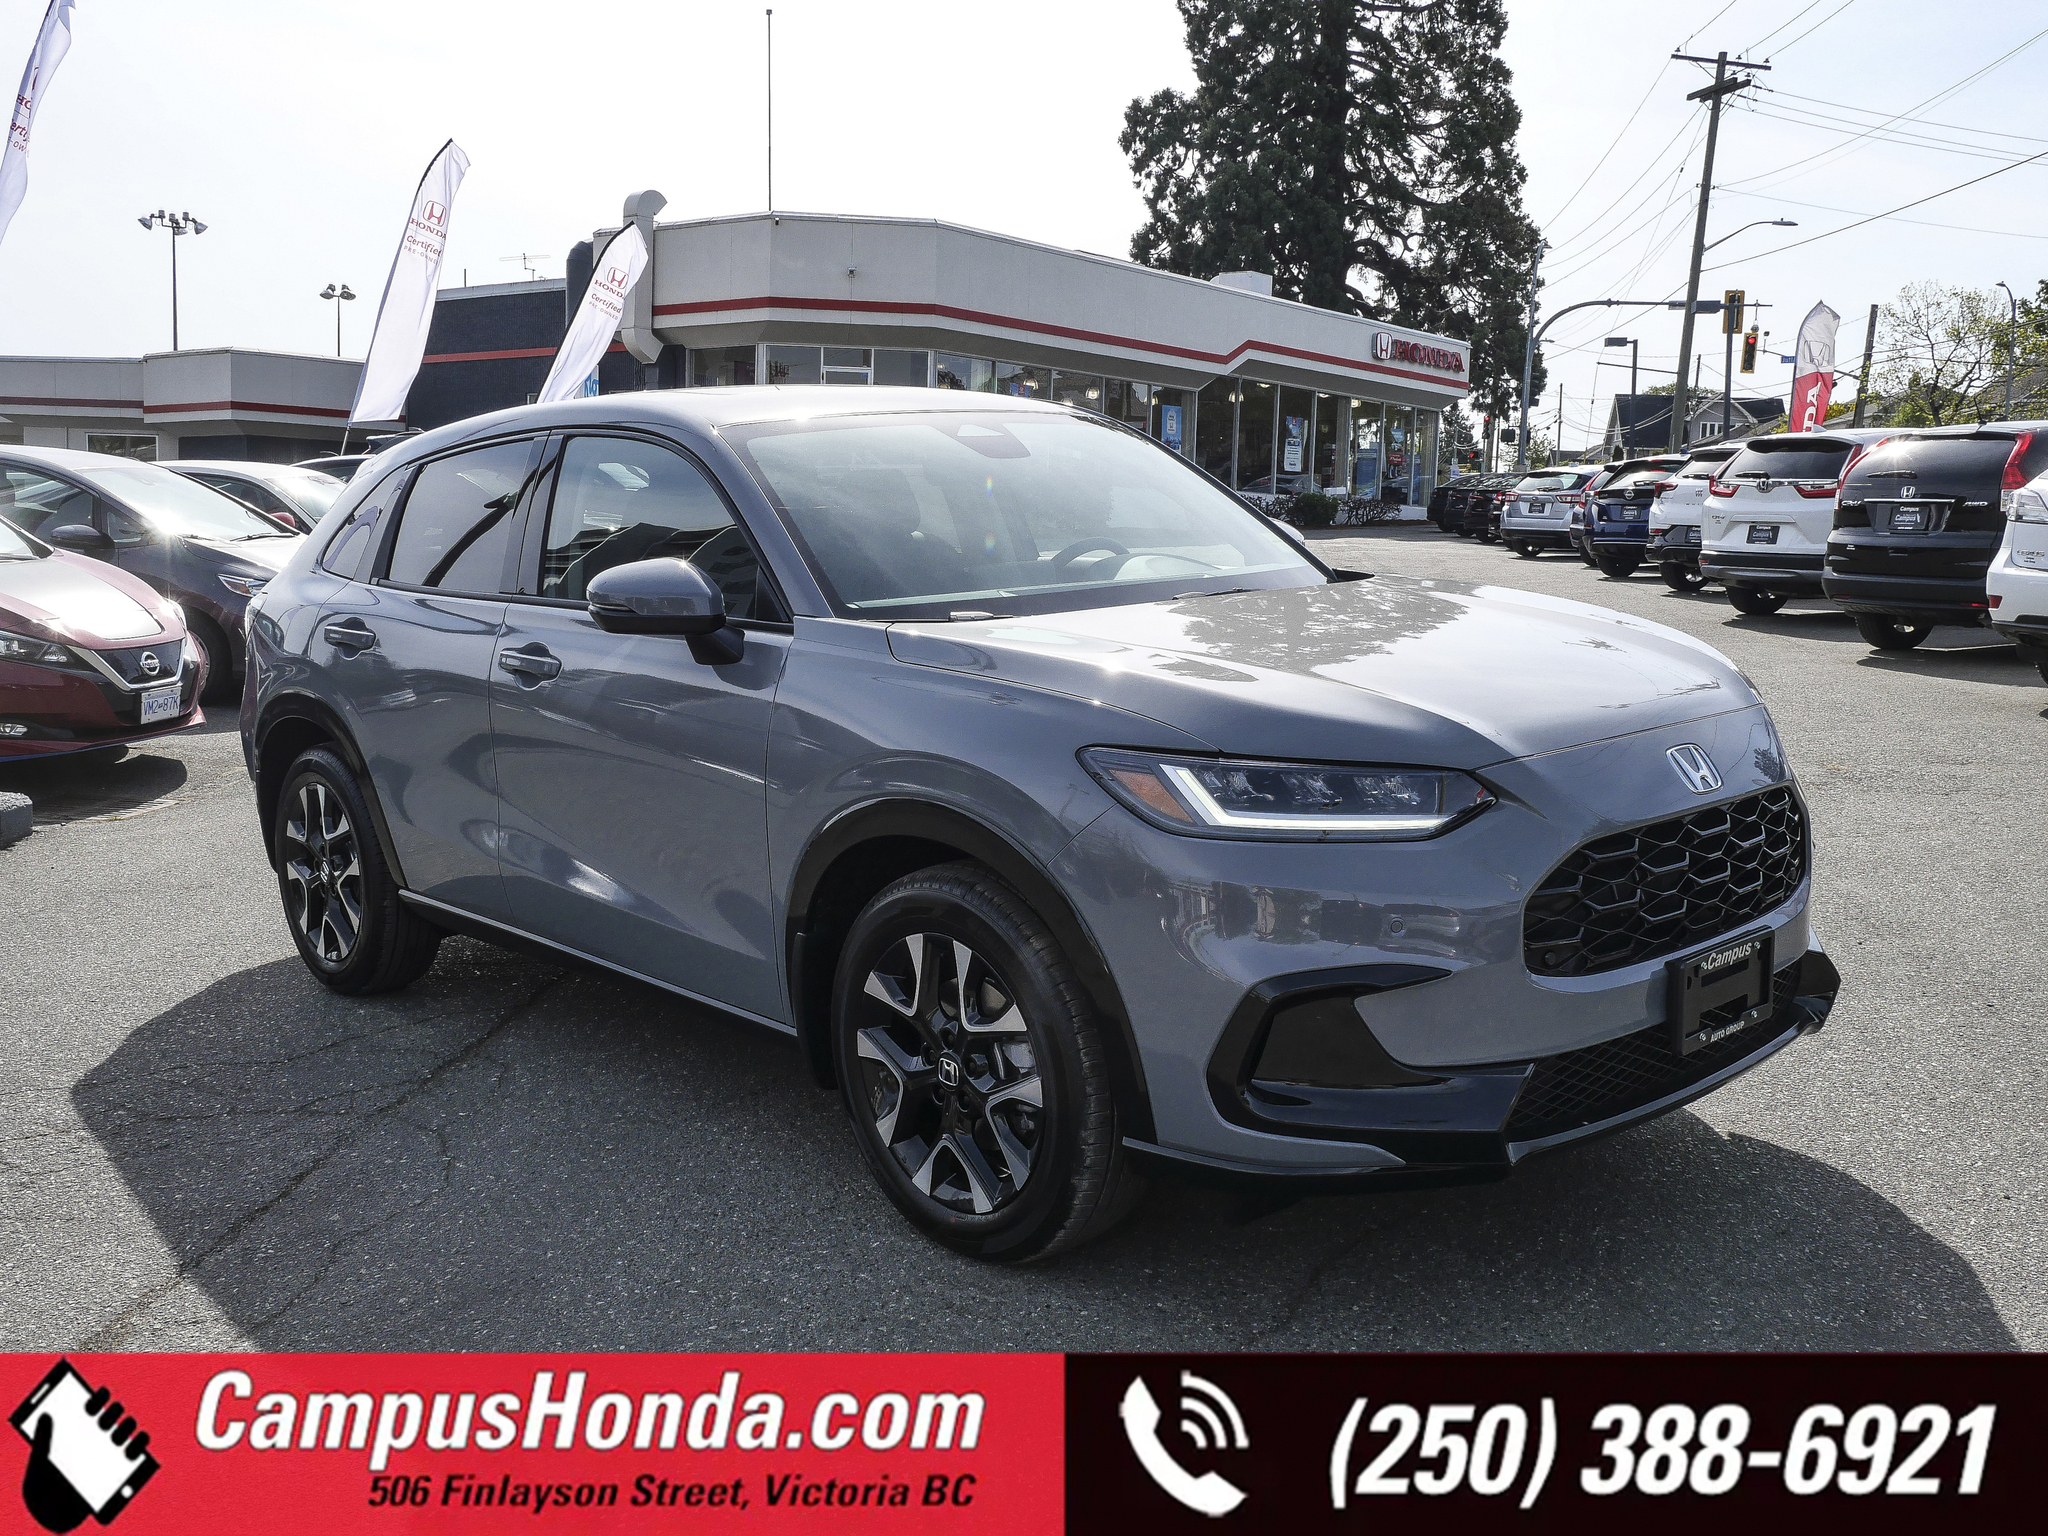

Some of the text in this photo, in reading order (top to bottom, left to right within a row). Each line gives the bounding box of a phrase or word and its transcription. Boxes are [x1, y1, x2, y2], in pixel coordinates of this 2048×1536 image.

[410, 217, 447, 241] HONDA
[591, 293, 623, 314] Certified
[1394, 339, 1465, 372] HONDA
[1707, 942, 1752, 970] Campus
[1710, 1020, 1746, 1043] AUTO GROUP
